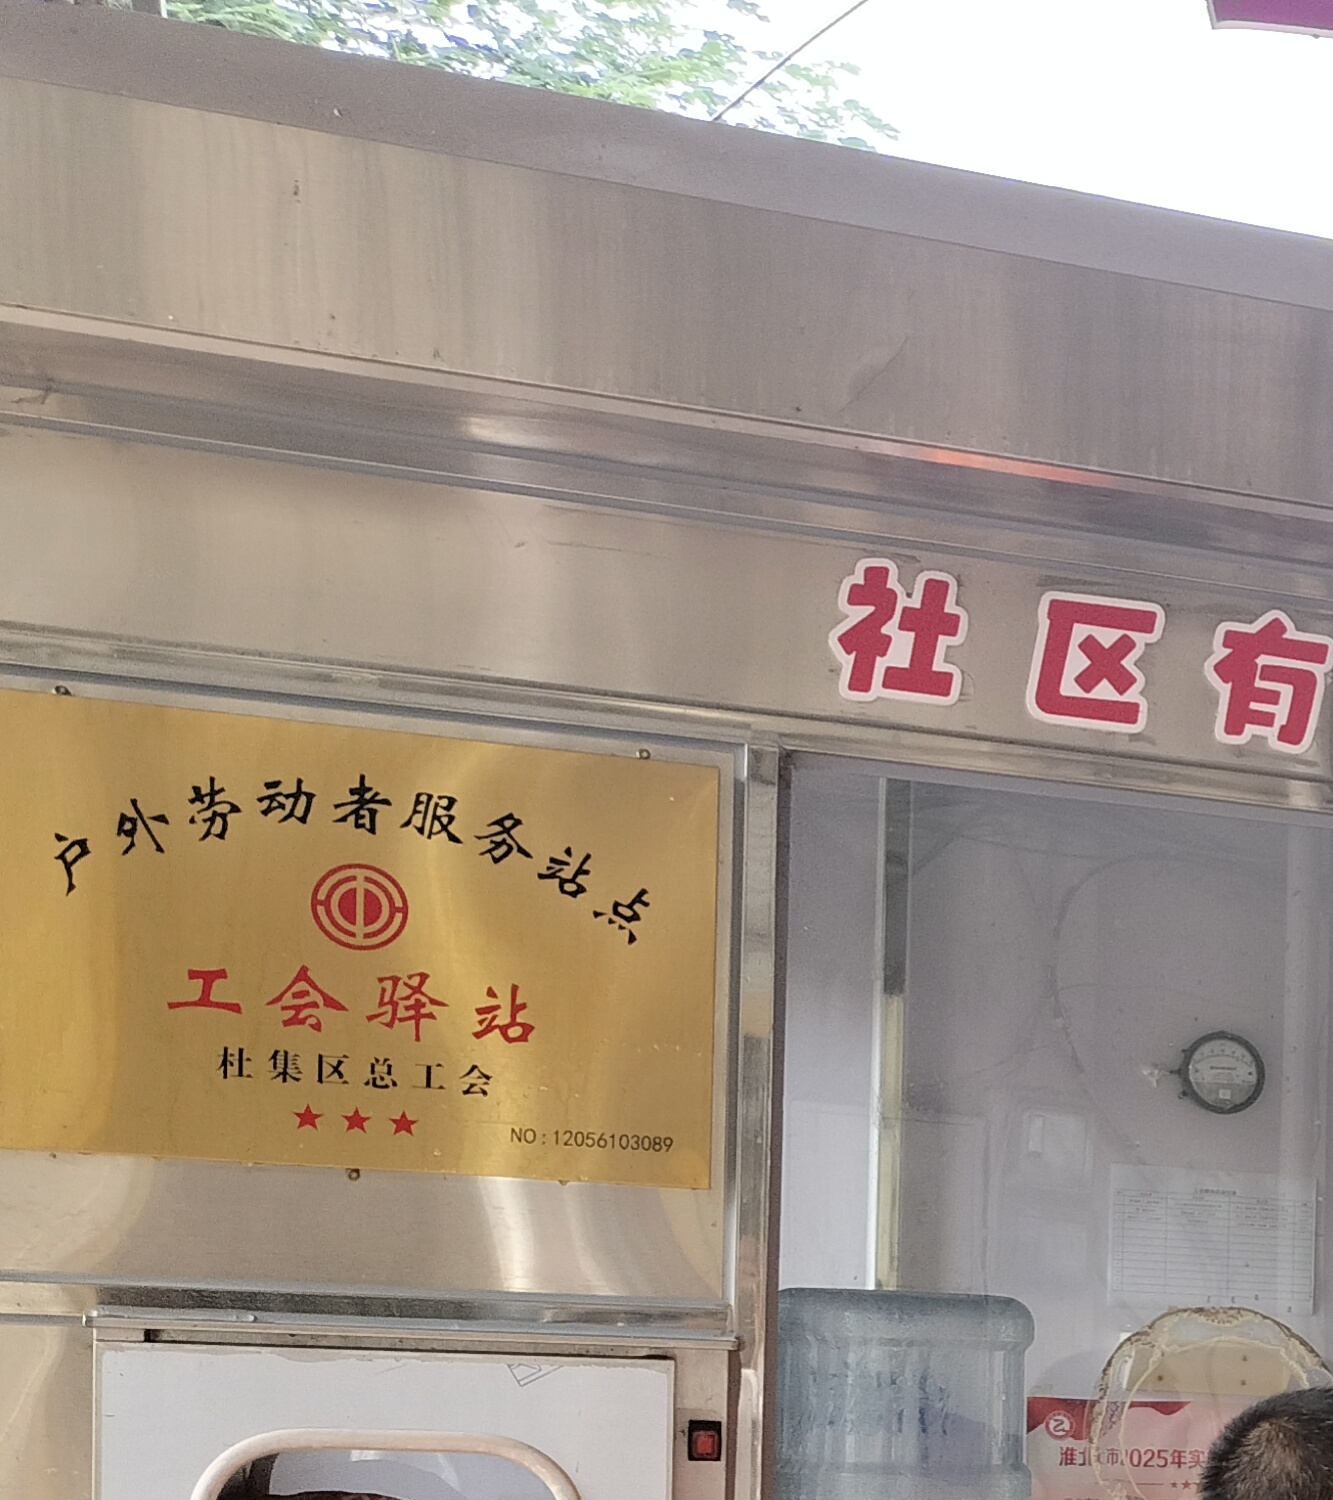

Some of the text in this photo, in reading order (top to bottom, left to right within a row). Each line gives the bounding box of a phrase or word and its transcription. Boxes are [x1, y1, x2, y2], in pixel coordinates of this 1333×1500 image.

[53, 774, 650, 945] 户外劳动者服务站点
[167, 964, 537, 1044] 工会驿站
[215, 1046, 494, 1097] 杜集区总工会
[1059, 1446, 1206, 1470] 淮北市025年实
